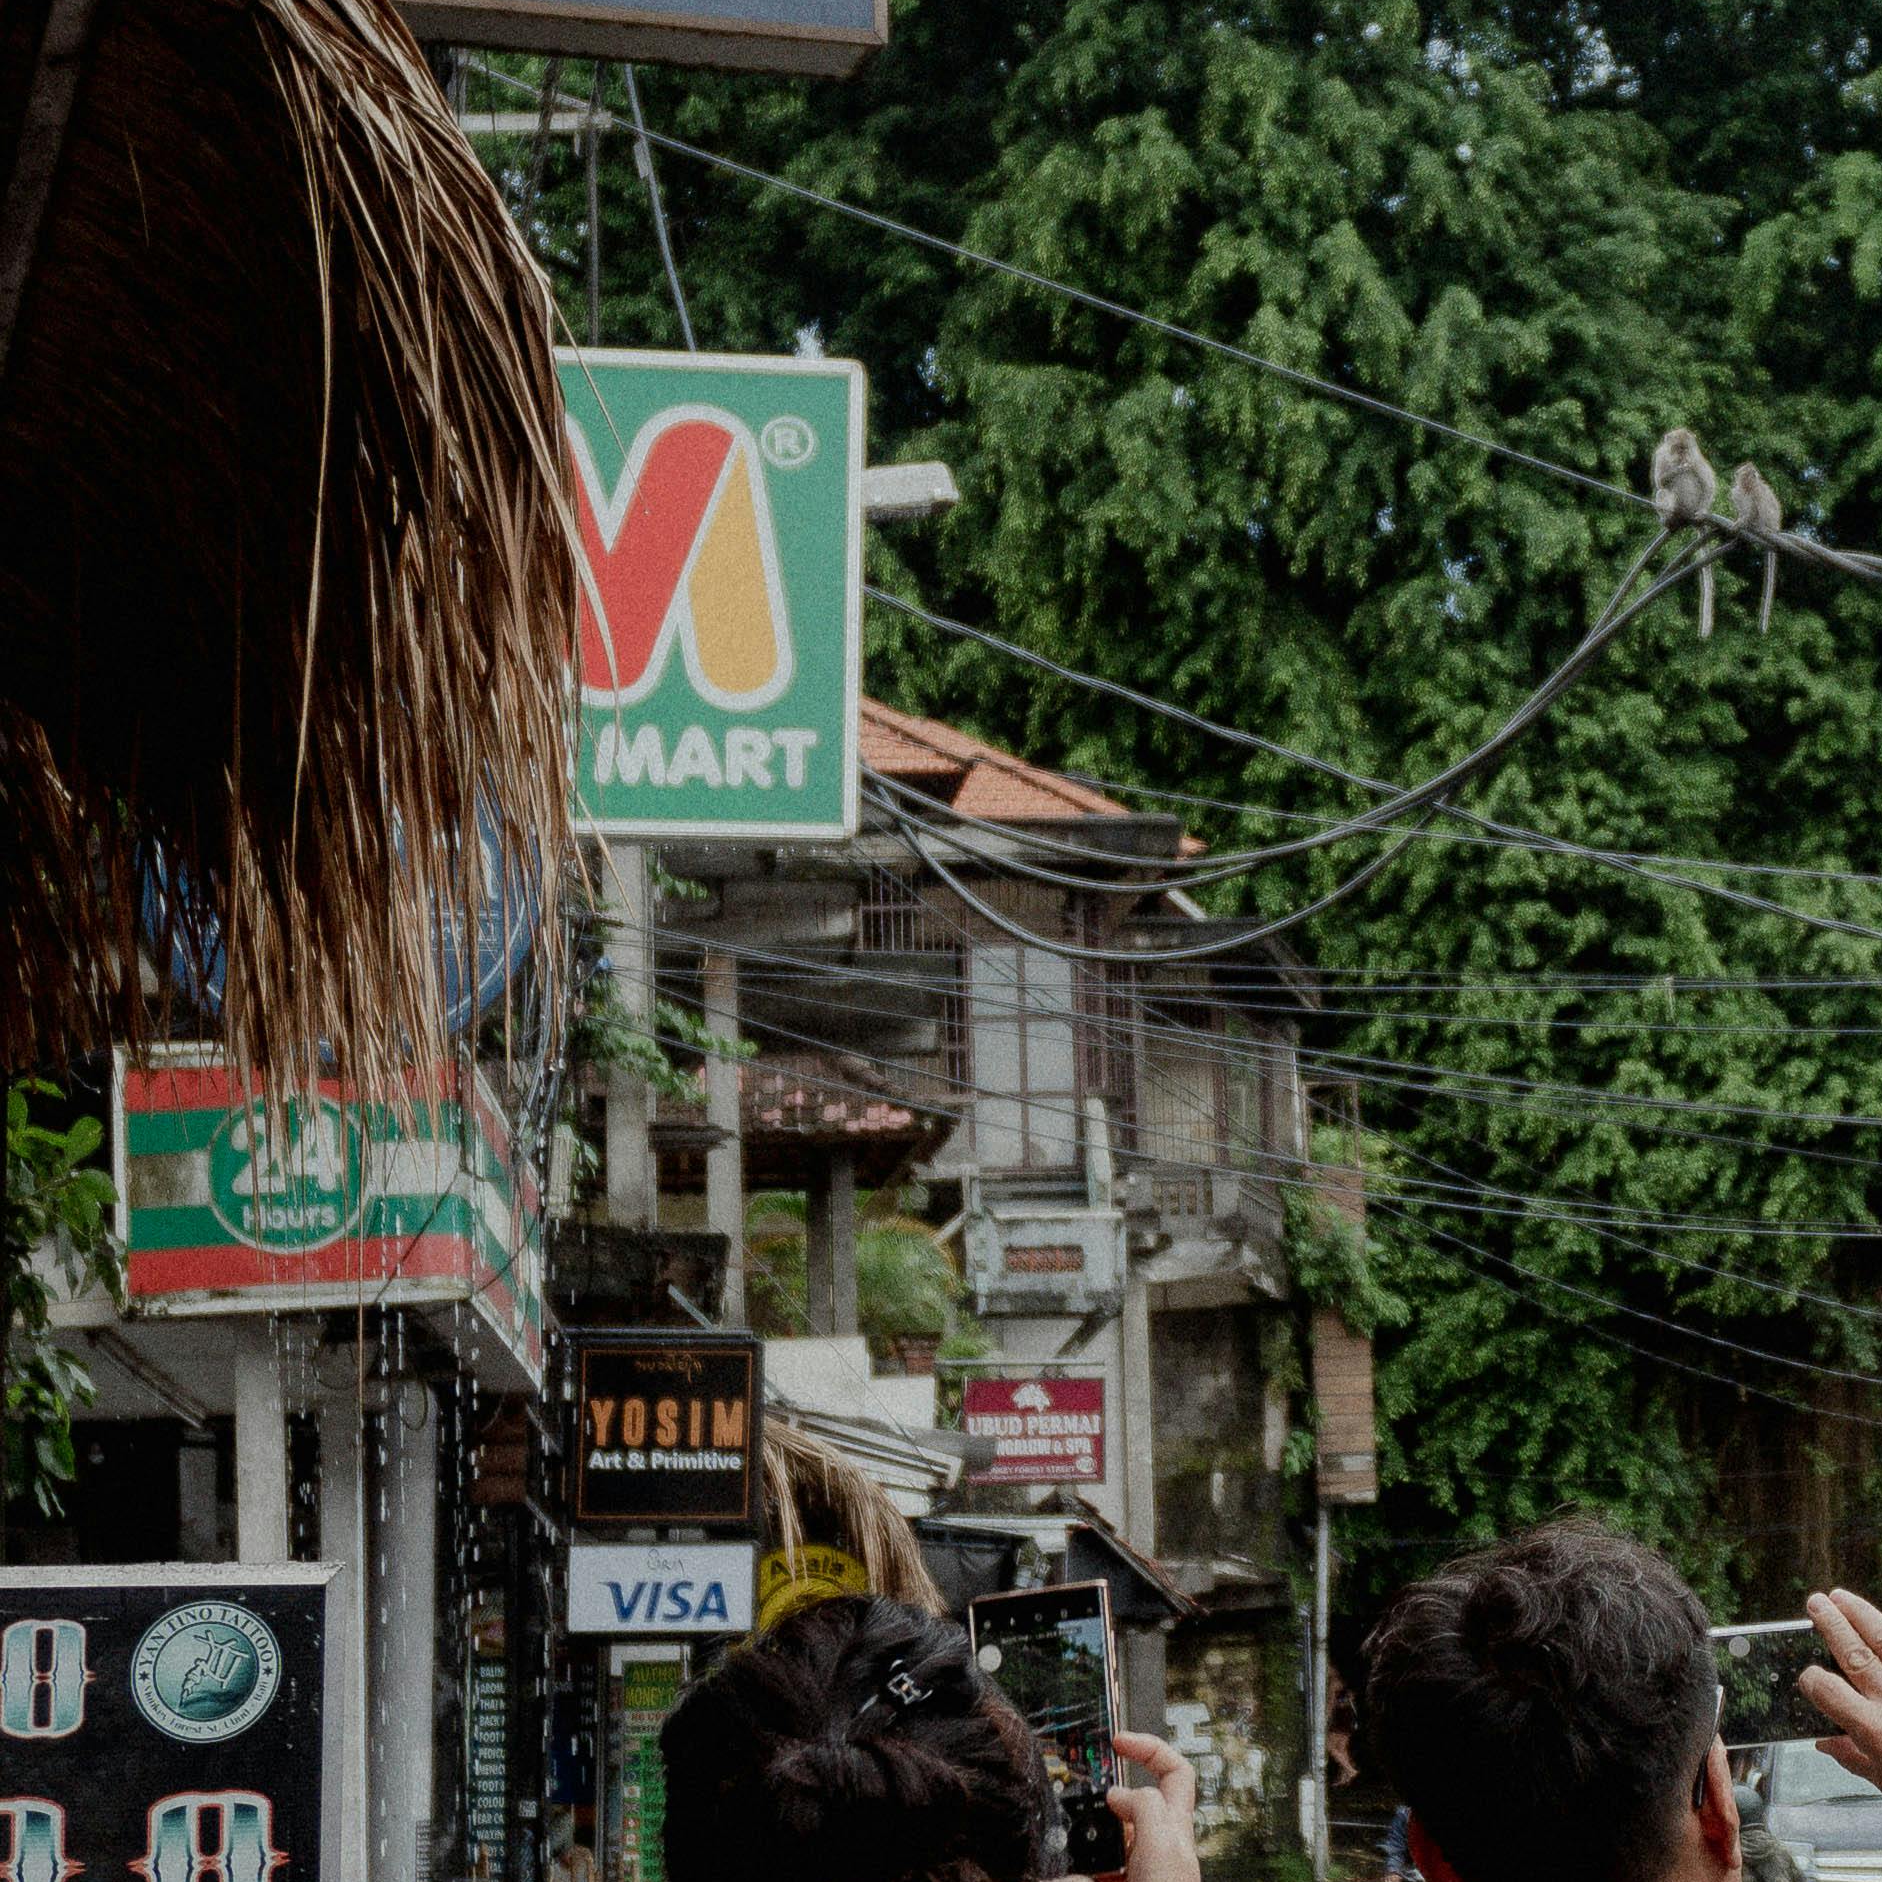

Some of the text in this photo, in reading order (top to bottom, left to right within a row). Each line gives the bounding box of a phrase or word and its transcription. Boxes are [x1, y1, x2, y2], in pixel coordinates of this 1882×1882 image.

[593, 724, 817, 789] MART
[229, 1113, 342, 1196] 24
[242, 1201, 337, 1232] Hours
[590, 1398, 744, 1448] YOSIM
[967, 1413, 1101, 1436] UBUD PERMAI
[589, 1451, 742, 1469] Art & Primitive
[1065, 1437, 1092, 1454] SPA
[598, 1580, 730, 1623] VISA
[138, 1607, 274, 1667] YAN TINO TATTOO
